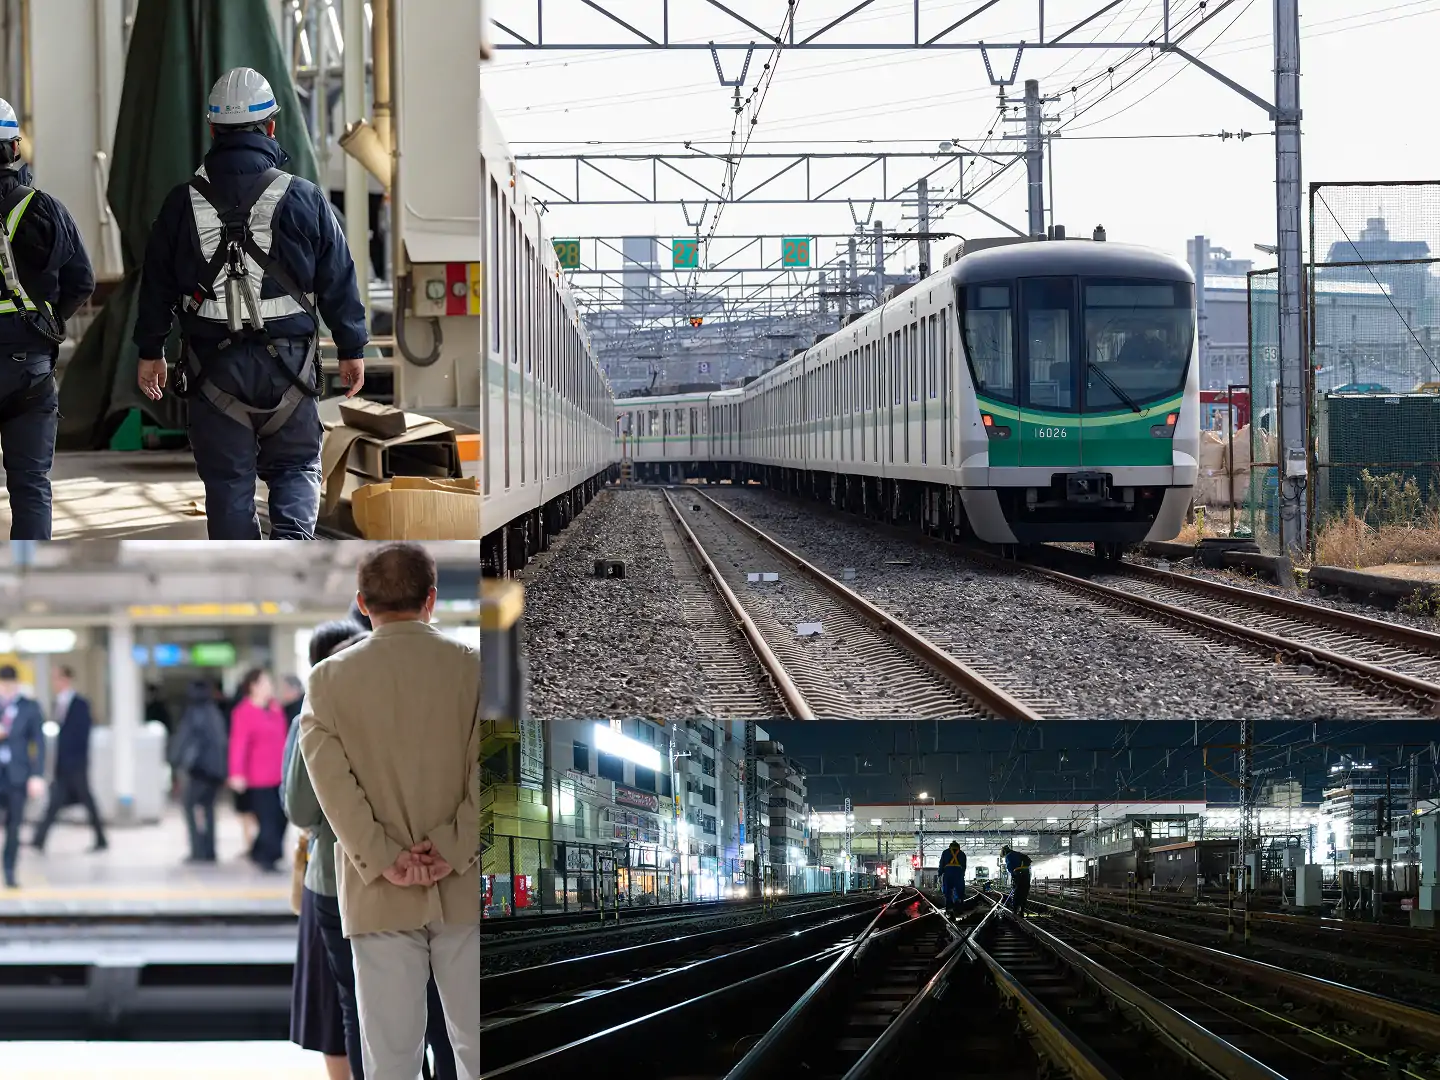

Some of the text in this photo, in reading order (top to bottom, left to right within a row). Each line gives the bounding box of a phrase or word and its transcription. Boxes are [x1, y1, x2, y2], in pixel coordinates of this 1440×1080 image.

[673, 243, 697, 264] 27
[785, 242, 808, 263] 26
[1034, 427, 1067, 438] 16026
